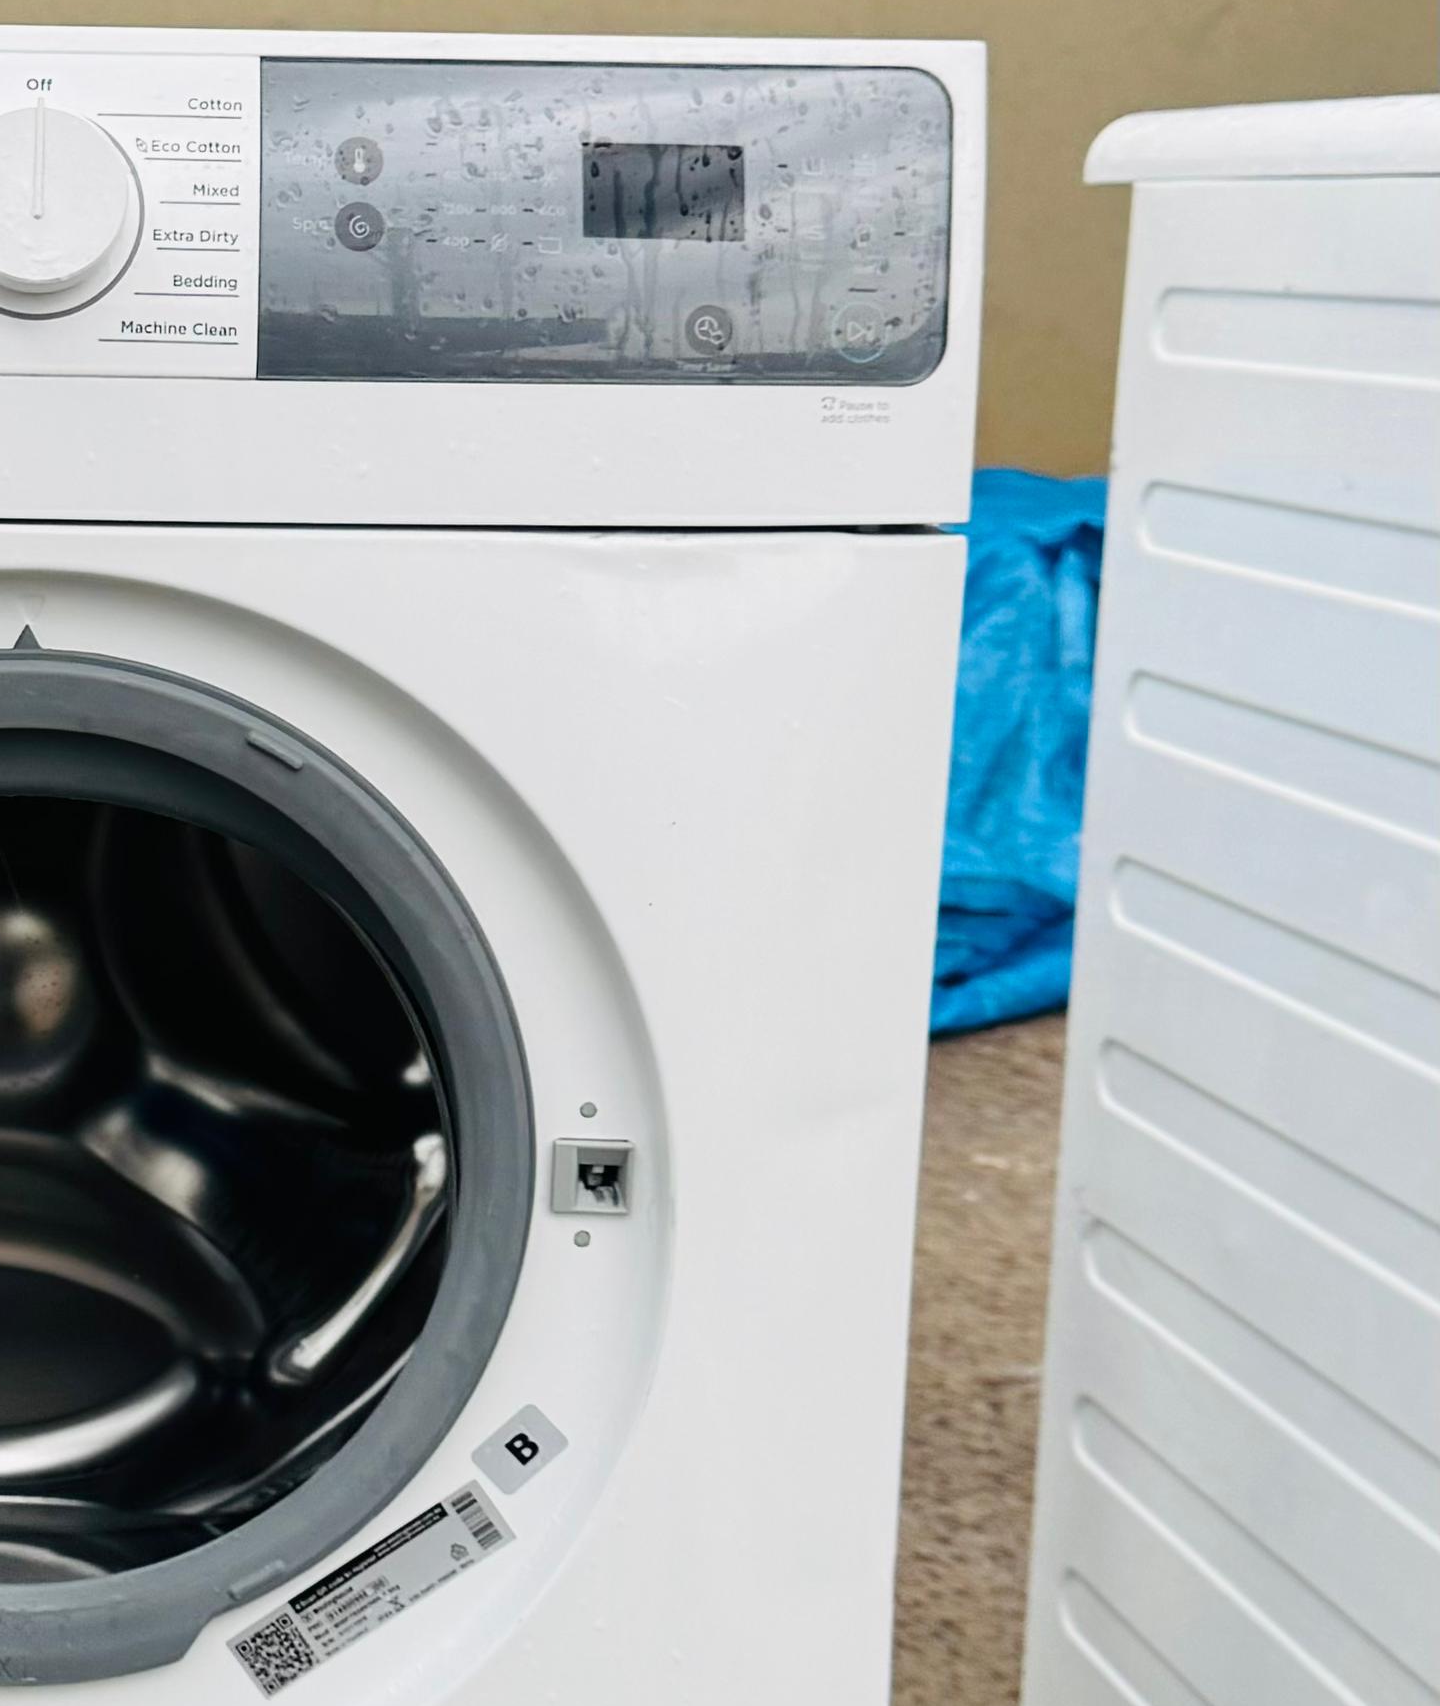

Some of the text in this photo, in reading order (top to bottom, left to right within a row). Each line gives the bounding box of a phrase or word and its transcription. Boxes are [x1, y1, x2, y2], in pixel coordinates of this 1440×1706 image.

[27, 78, 52, 92] Off
[187, 98, 243, 112] Cotton
[151, 140, 241, 154] Eco Cotton
[192, 184, 240, 198] Mixed
[152, 229, 239, 246] Extra Dirty
[172, 275, 238, 291] Bedding
[120, 321, 238, 337] Machine Clean
[504, 1433, 540, 1466] B
